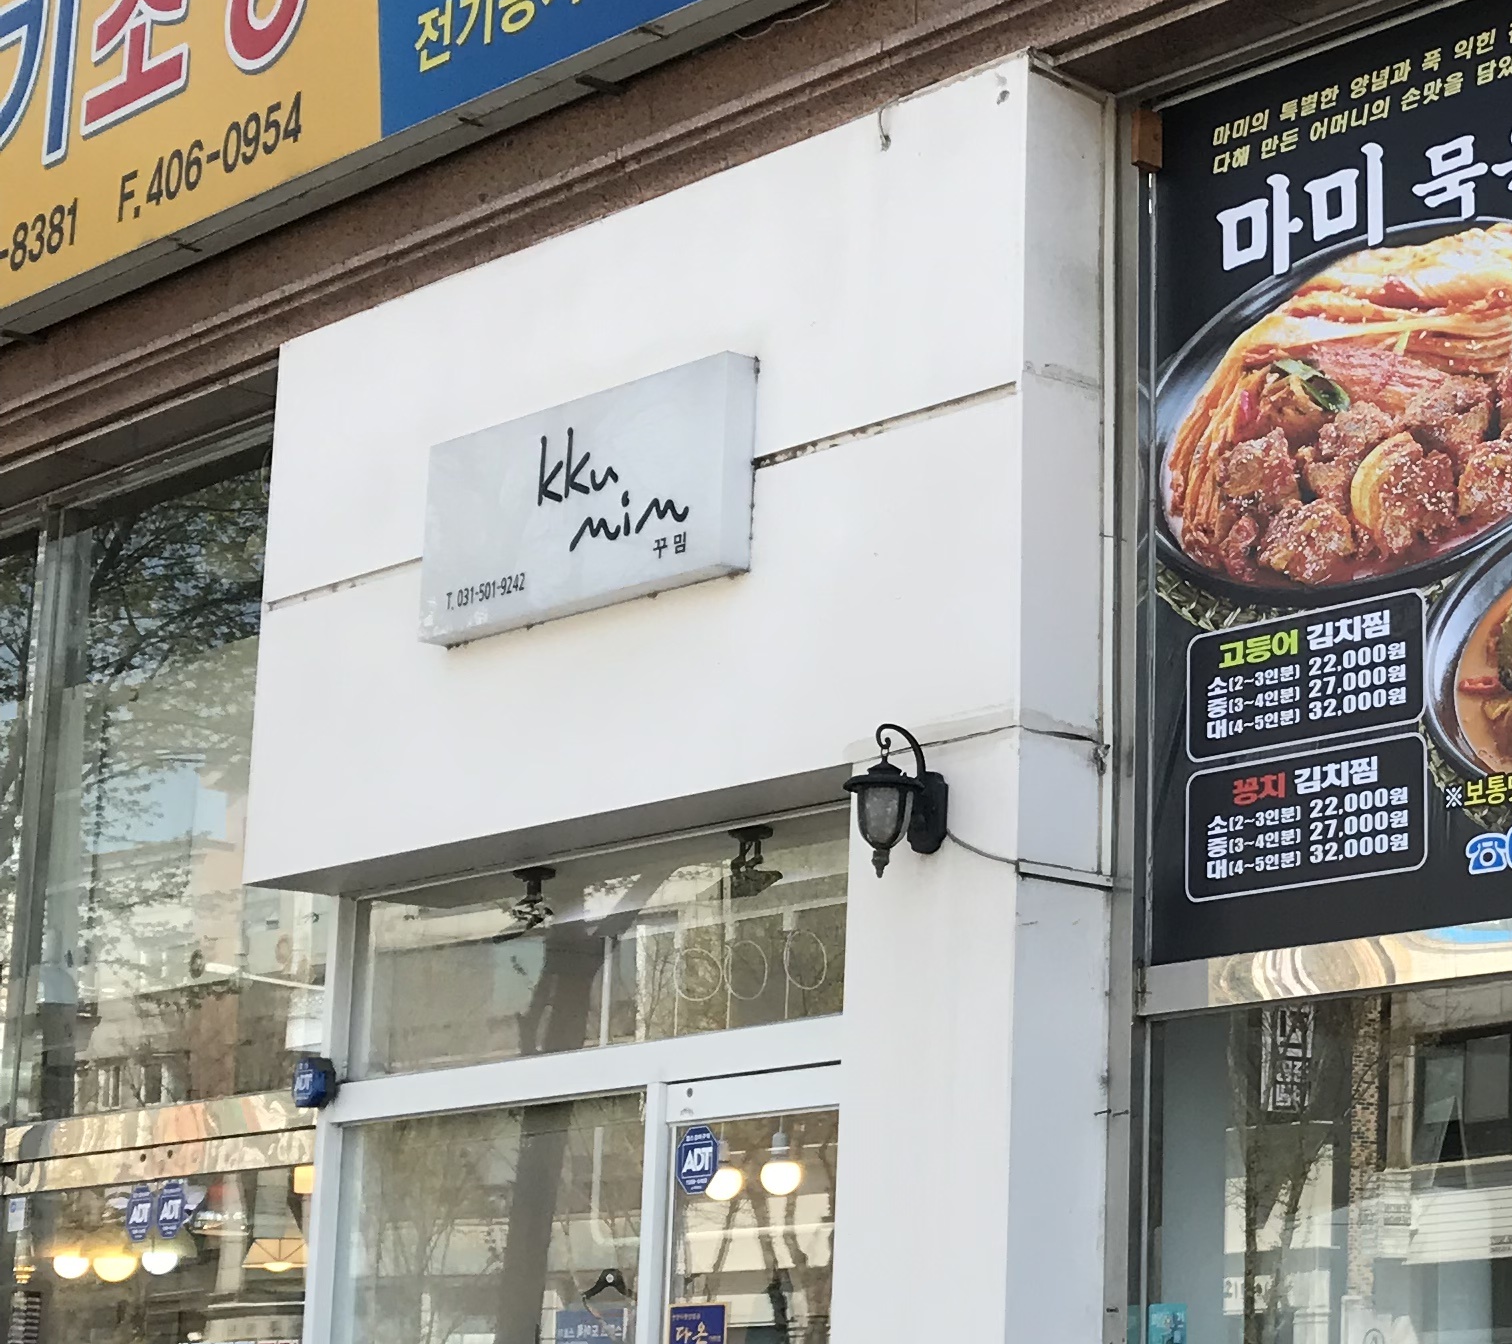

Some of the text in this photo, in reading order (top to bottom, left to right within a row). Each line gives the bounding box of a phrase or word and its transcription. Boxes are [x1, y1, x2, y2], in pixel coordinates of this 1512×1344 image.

[1212, 109, 1269, 146] 마미의
[1279, 85, 1339, 121] 특별한
[1350, 58, 1411, 99] 양념과
[1421, 47, 1442, 71] 푹
[1454, 28, 1496, 59] 익힌
[1212, 145, 1250, 175] 다해
[1260, 127, 1299, 160] 만든
[1310, 95, 1391, 142] 어머니의
[1400, 71, 1464, 112] 손맛을
[117, 90, 303, 223] F.406-0954
[1215, 142, 1385, 276] 마미
[537, 426, 618, 507] kku
[1218, 609, 1391, 669] 고등어 김치찜
[1308, 641, 1406, 677] 22,000원
[1308, 664, 1407, 698] 27,000원
[1308, 687, 1407, 721] 32,000원
[1232, 756, 1378, 807] 꽁치 김치찜
[1309, 786, 1409, 819] 22,000원
[1309, 809, 1409, 842] 27,000원
[1309, 832, 1409, 864] 32,000원
[681, 1146, 713, 1174] ADT
[159, 1198, 182, 1222] ADT
